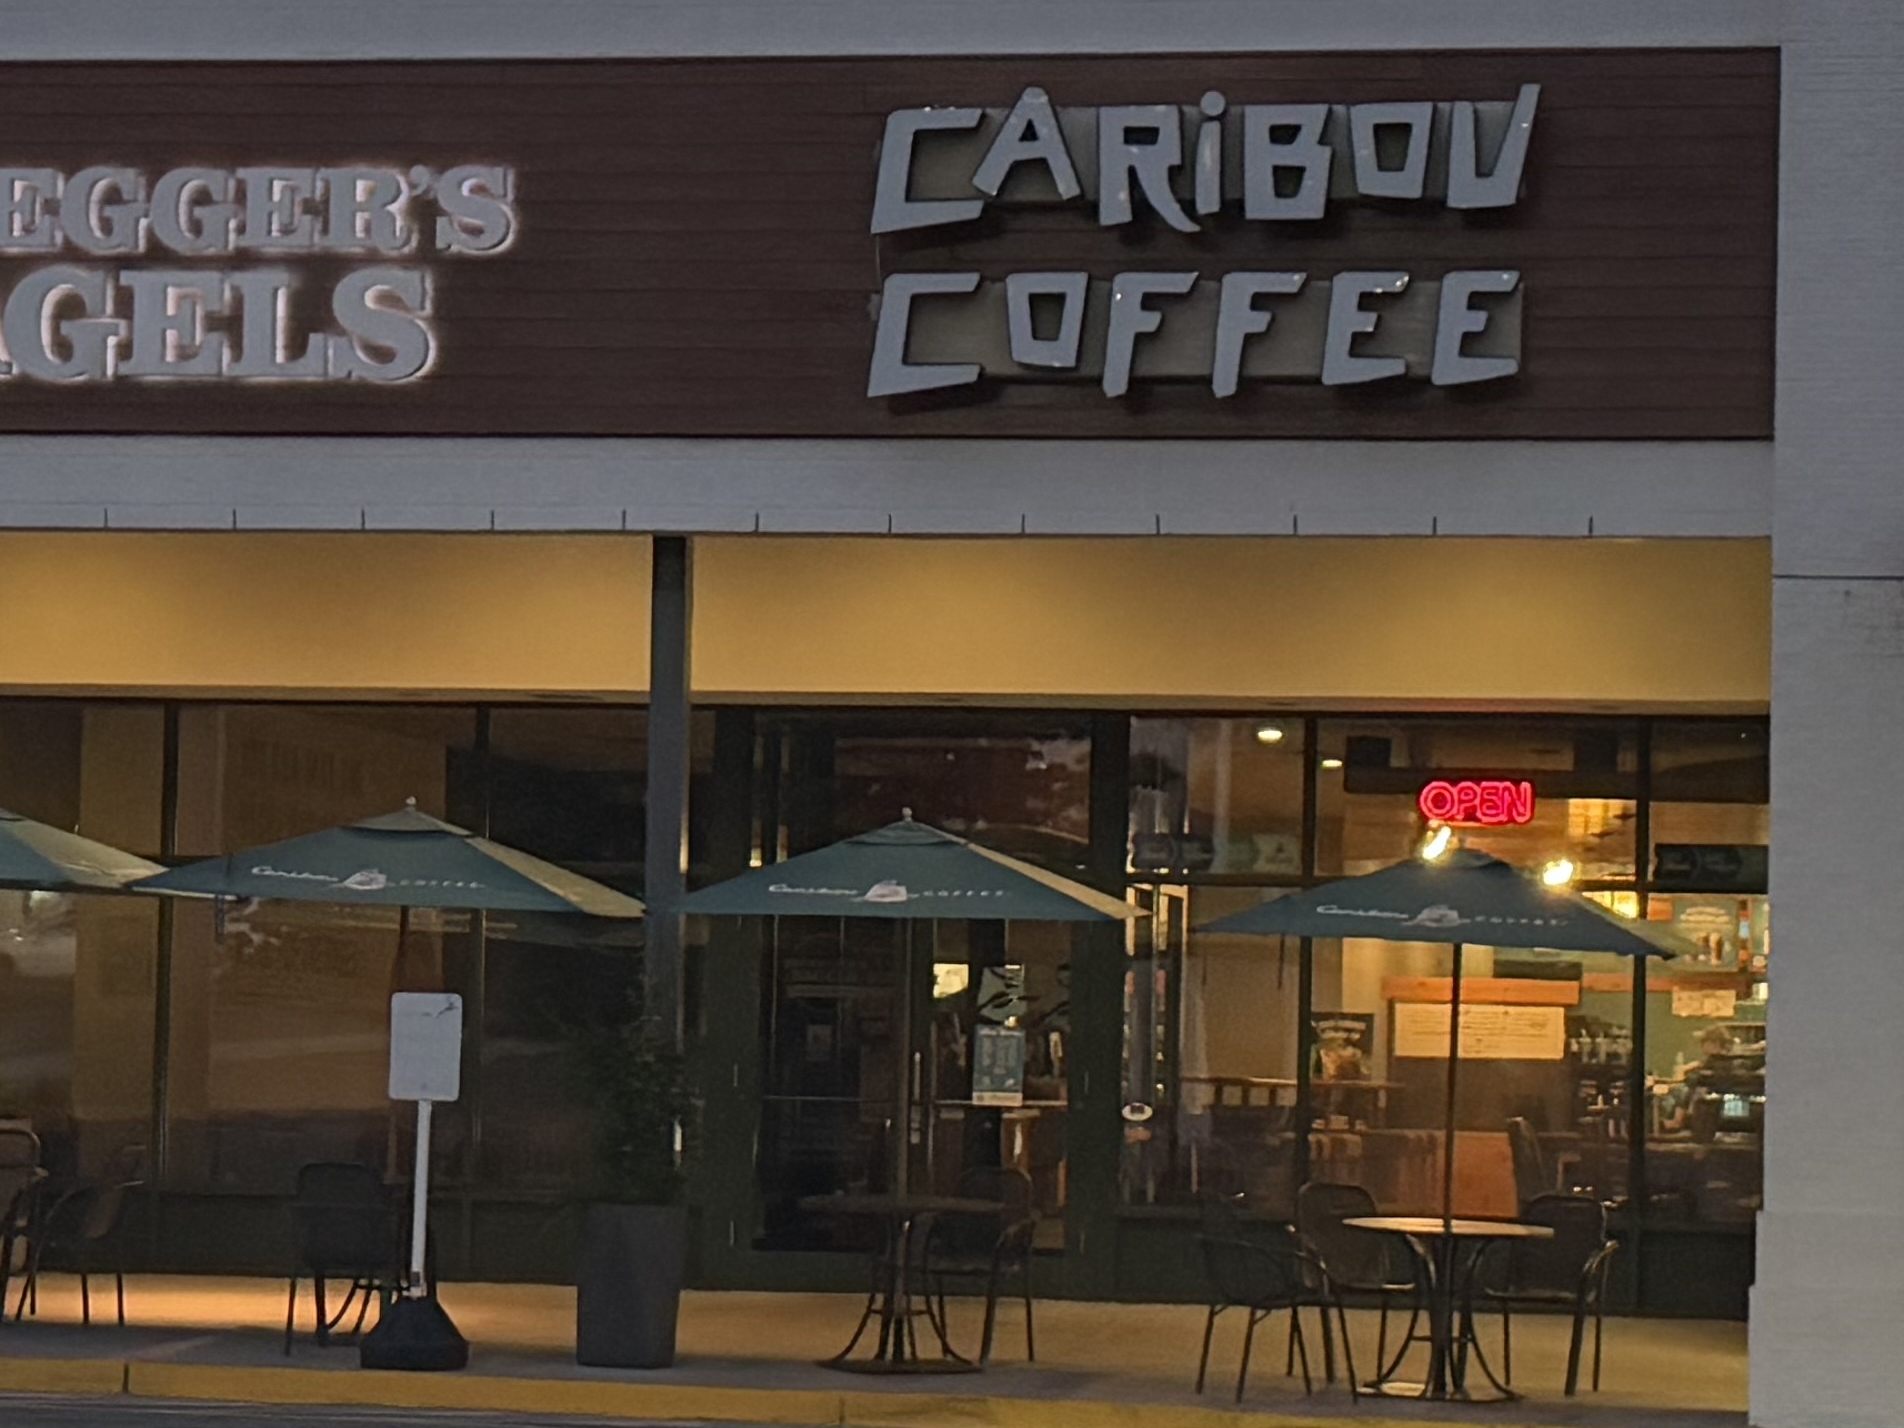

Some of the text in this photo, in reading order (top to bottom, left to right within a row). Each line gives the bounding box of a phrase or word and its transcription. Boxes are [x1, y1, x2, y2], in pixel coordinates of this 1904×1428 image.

[871, 83, 1541, 235] CARiBOU
[867, 272, 1521, 398] COFFEE
[1419, 780, 1532, 823] OPEN
